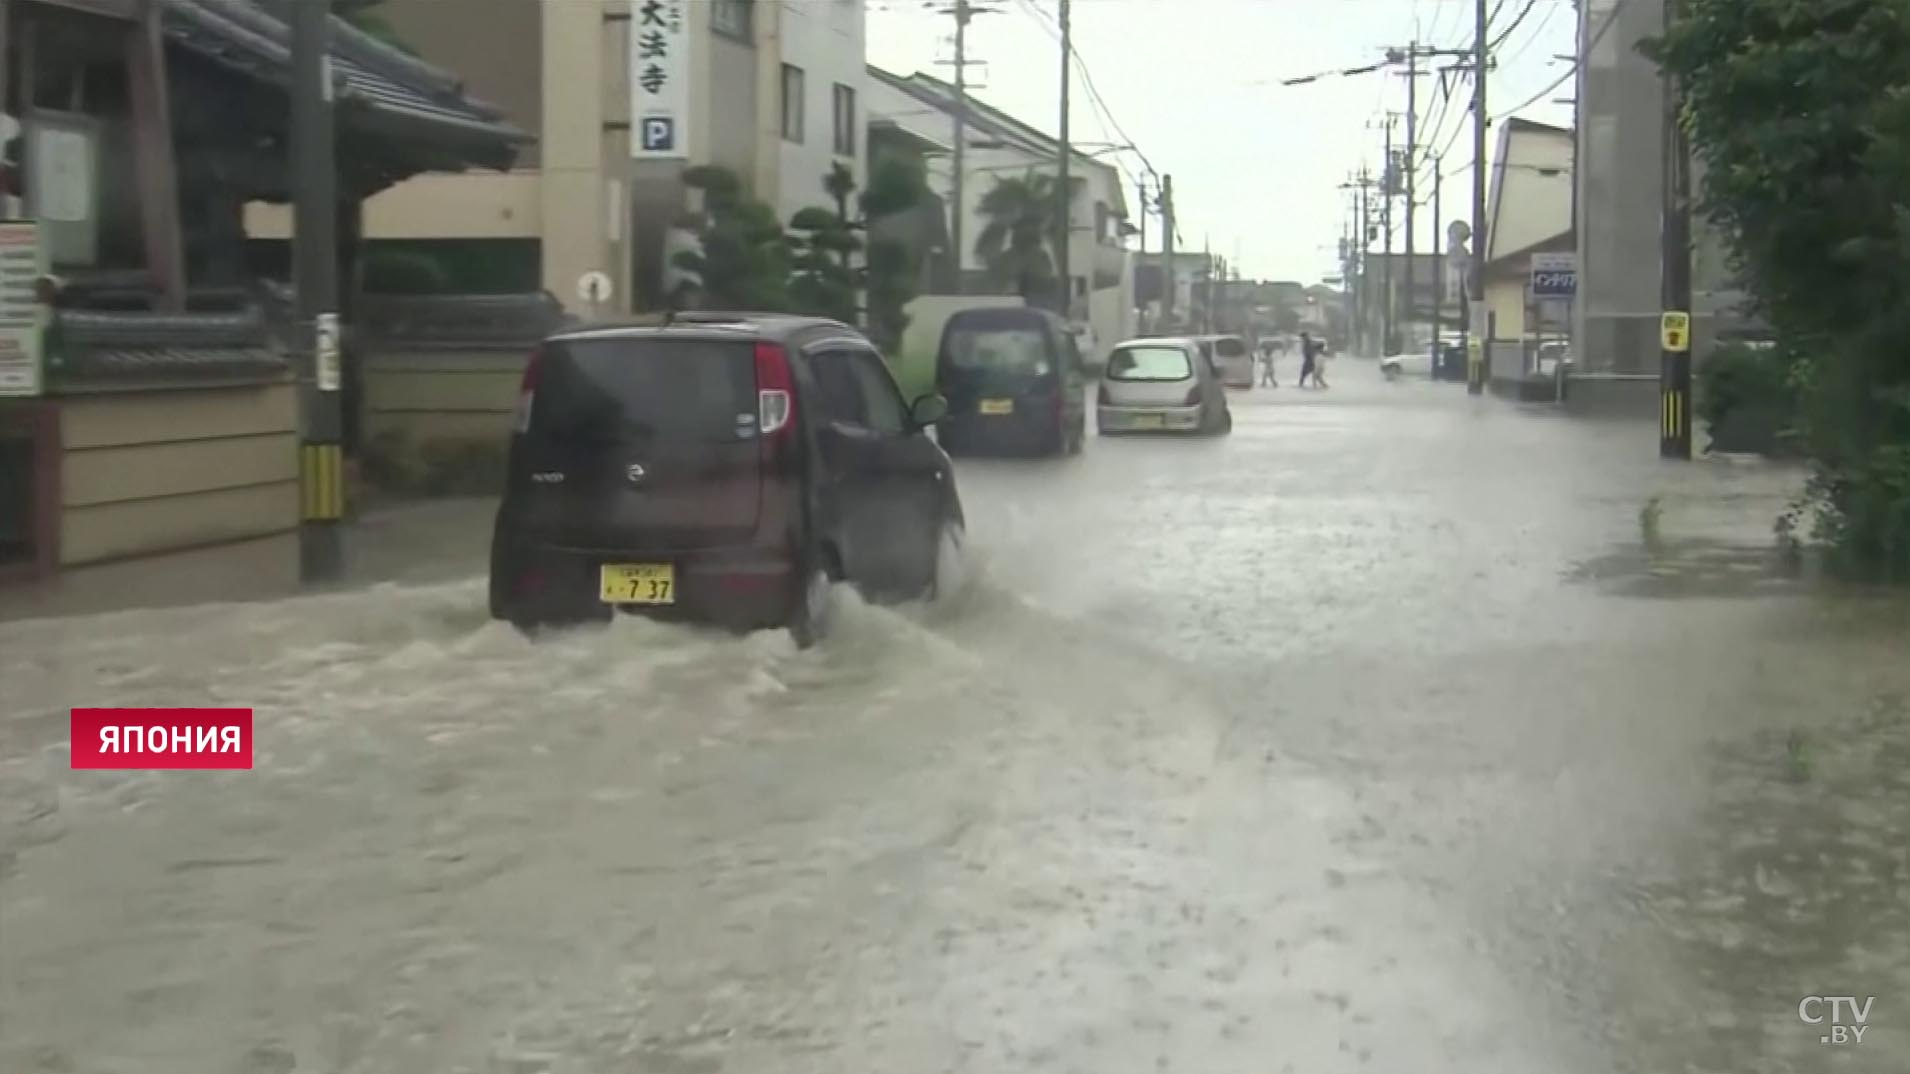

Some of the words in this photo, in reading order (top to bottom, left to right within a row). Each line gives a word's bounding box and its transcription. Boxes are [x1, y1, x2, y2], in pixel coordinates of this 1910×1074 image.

[638, 0, 668, 94] 大法寺
[646, 120, 669, 148] P
